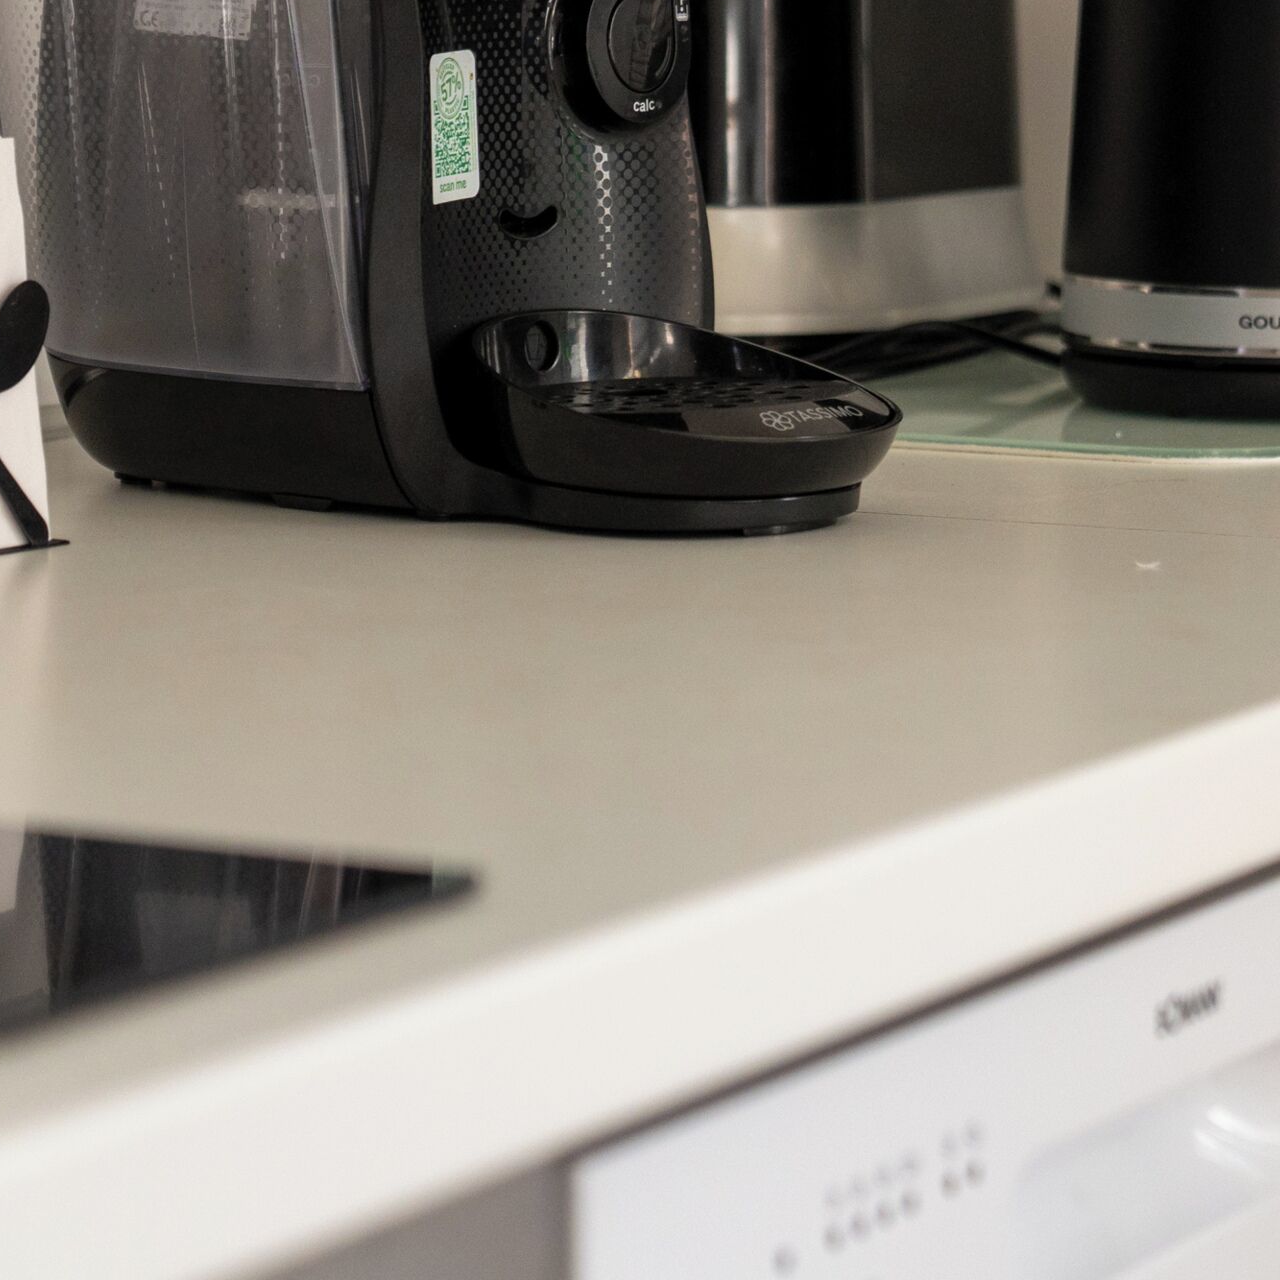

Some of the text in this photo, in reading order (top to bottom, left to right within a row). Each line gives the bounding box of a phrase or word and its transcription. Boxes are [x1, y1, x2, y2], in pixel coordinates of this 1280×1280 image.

[440, 71, 462, 102] 57%
[633, 98, 656, 113] calc
[439, 178, 467, 193] scan me
[785, 405, 864, 423] TASSIMO
